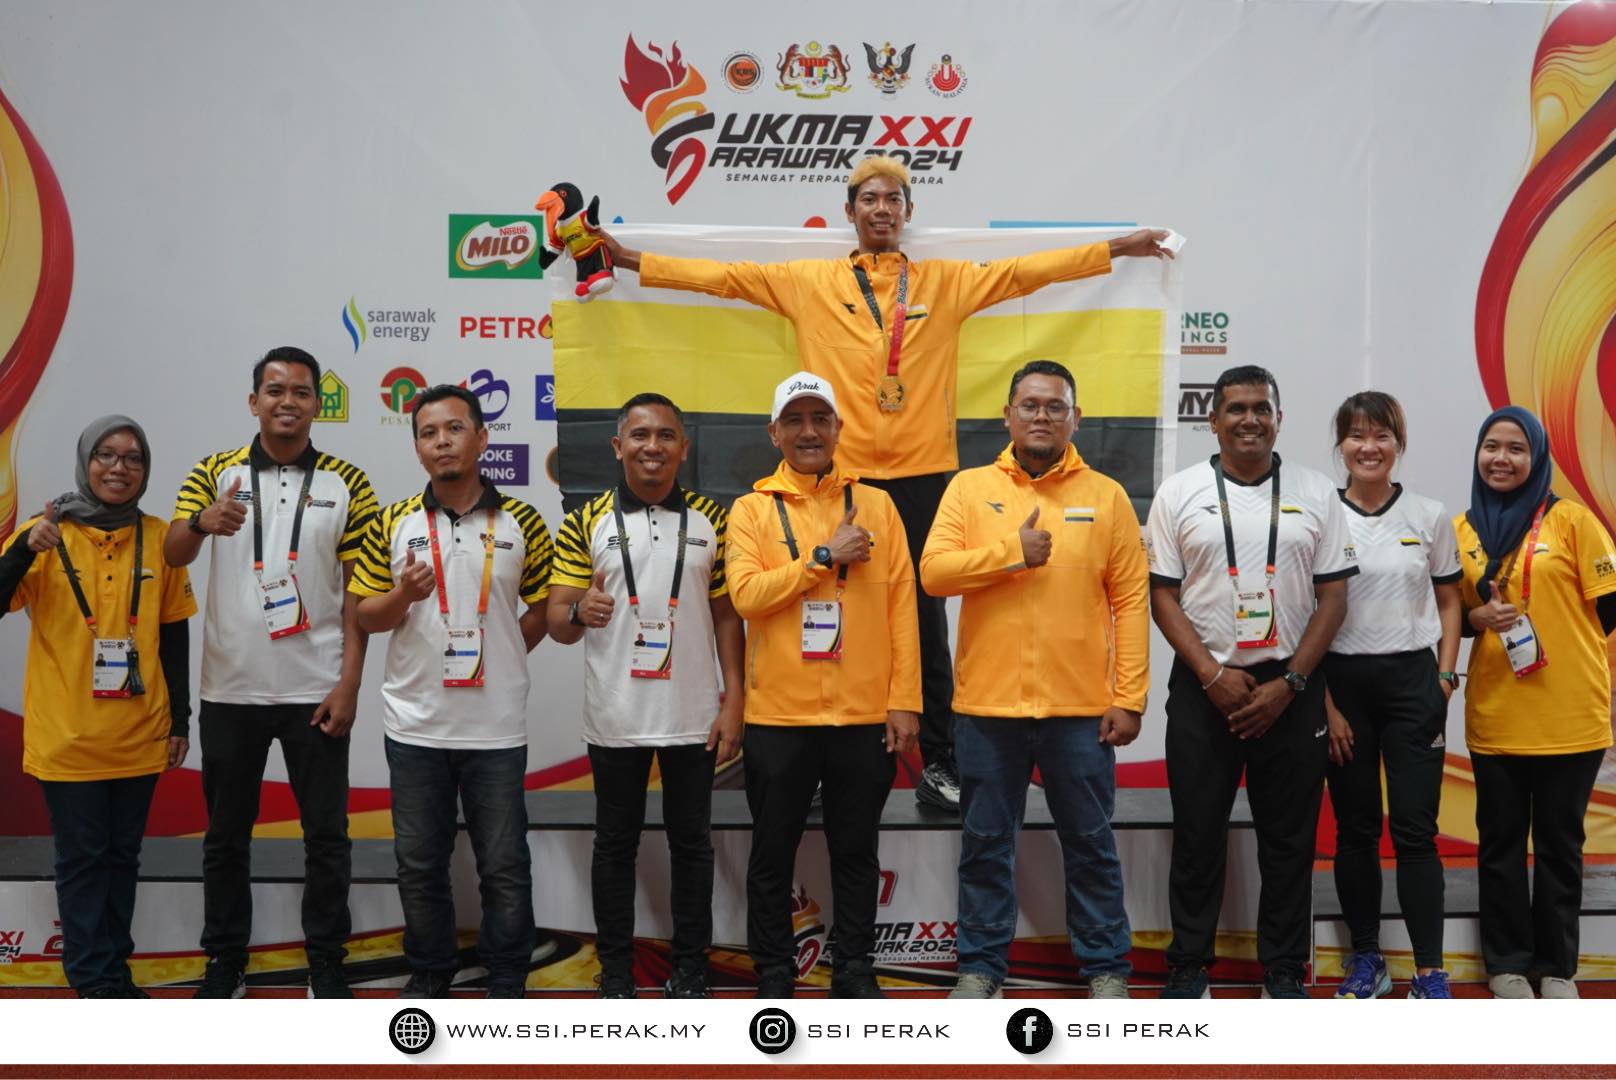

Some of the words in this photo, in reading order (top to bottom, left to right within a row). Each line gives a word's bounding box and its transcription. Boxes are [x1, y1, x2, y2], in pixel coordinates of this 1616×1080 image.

[872, 115, 973, 147] XXI
[726, 173, 796, 183] SEMANGAT
[800, 175, 849, 184] PERPAD
[911, 176, 944, 185] BARA
[467, 235, 531, 259] MILO
[367, 308, 436, 324] sarawak
[1181, 312, 1229, 329] NEO
[372, 325, 430, 342] energy
[381, 415, 411, 425] PUSA
[488, 423, 512, 432] PORT
[481, 468, 515, 480] DING
